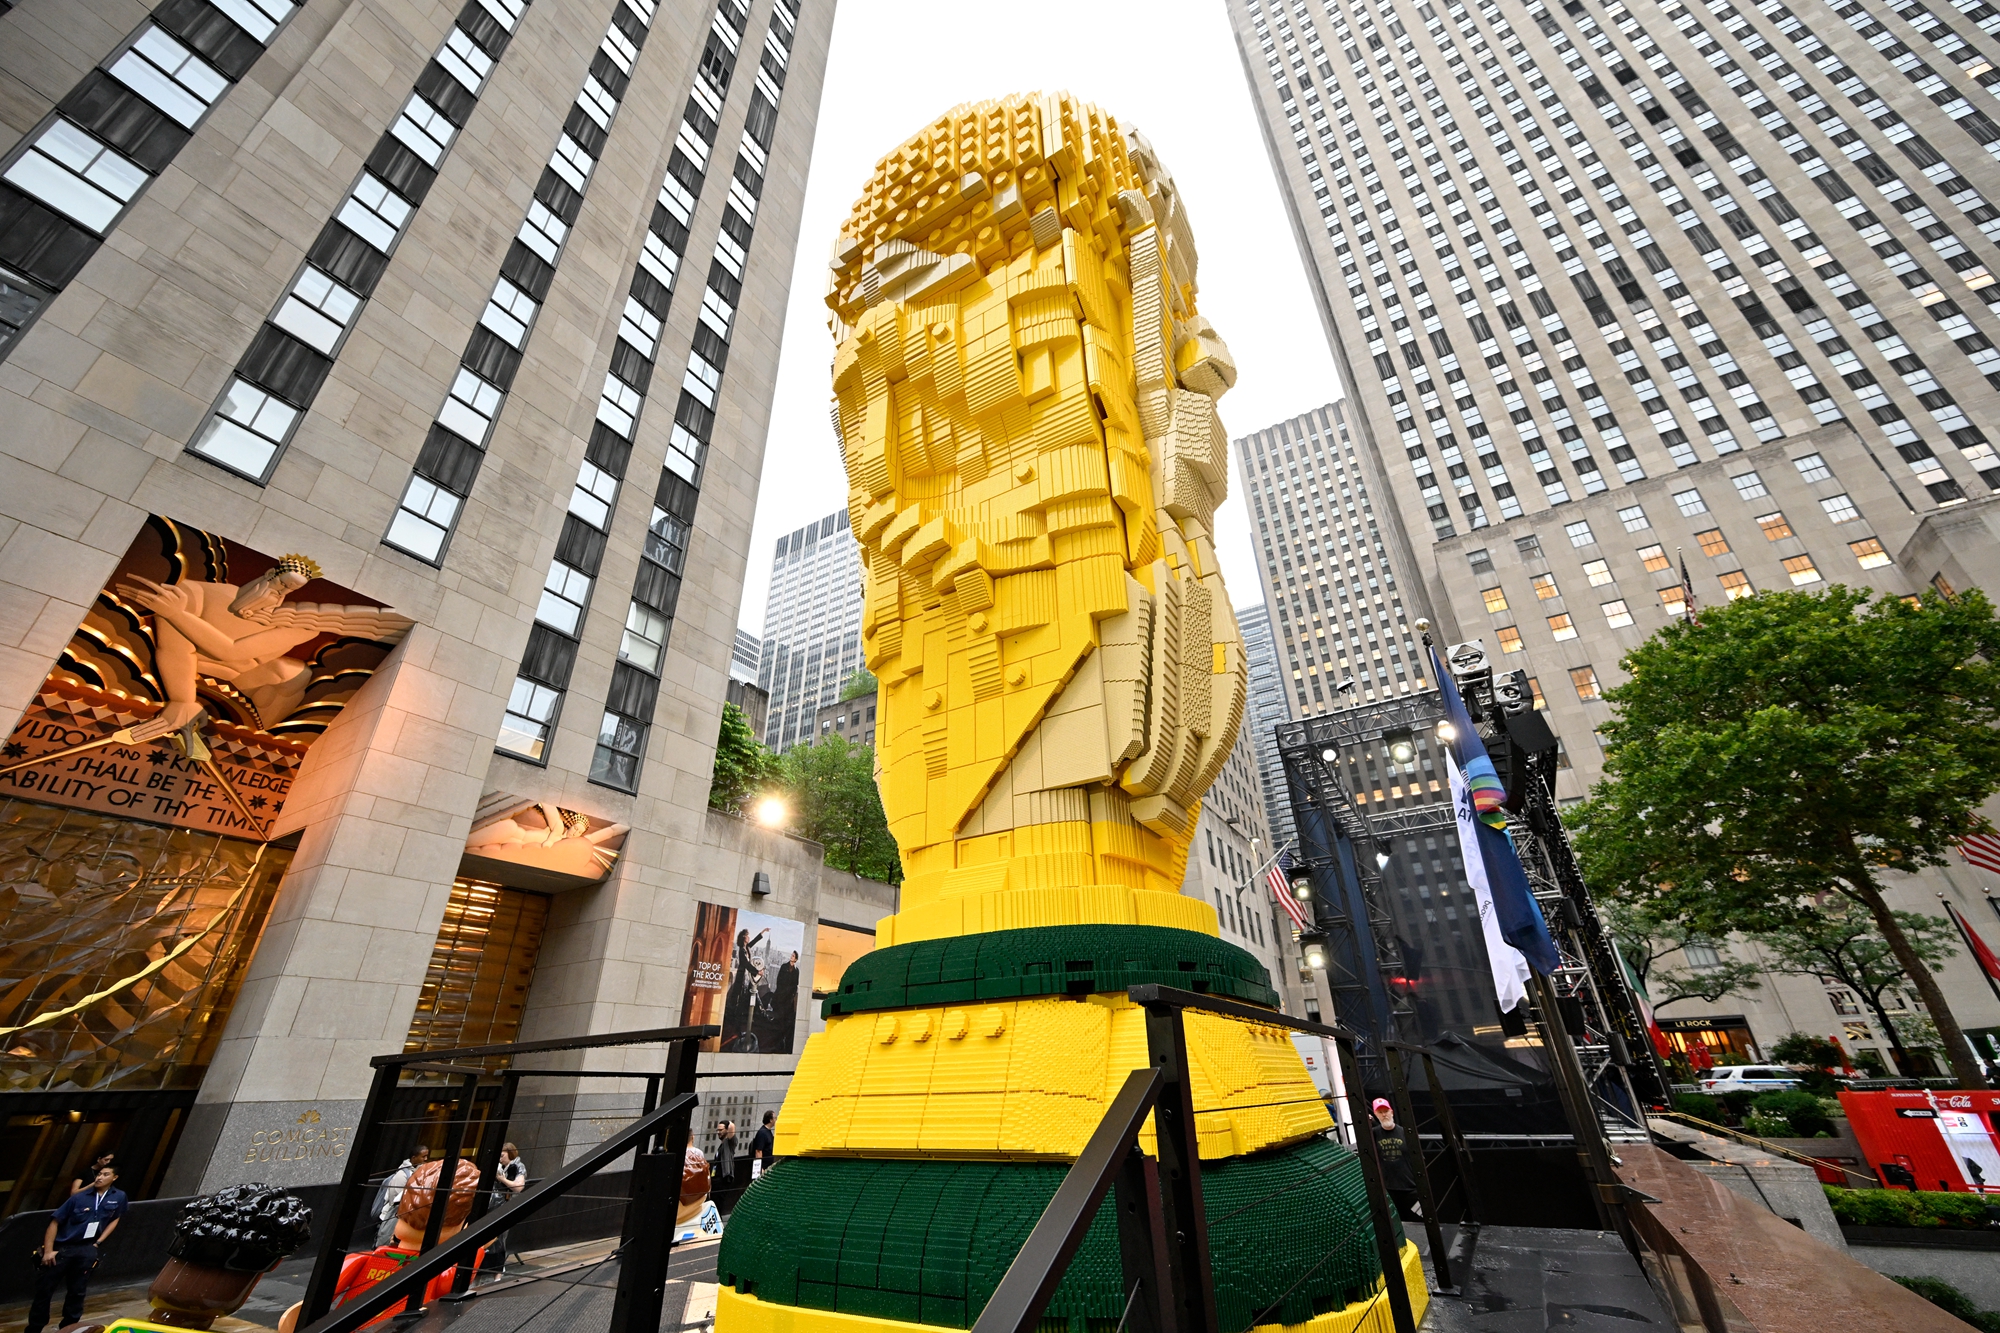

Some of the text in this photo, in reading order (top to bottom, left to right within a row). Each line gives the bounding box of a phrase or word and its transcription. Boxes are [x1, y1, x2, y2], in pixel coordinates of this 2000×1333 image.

[111, 748, 141, 761] AND
[67, 756, 218, 800] SHALL BE THE
[107, 788, 147, 808] OF
[152, 795, 200, 818] THY
[699, 962, 721, 971] TOP OF
[693, 970, 723, 981] THE ROCK
[1687, 1019, 1712, 1027] ROCK
[251, 1127, 352, 1146] COMCAST
[1378, 1138, 1403, 1147] TOKYO
[244, 1143, 346, 1164] BUILDING
